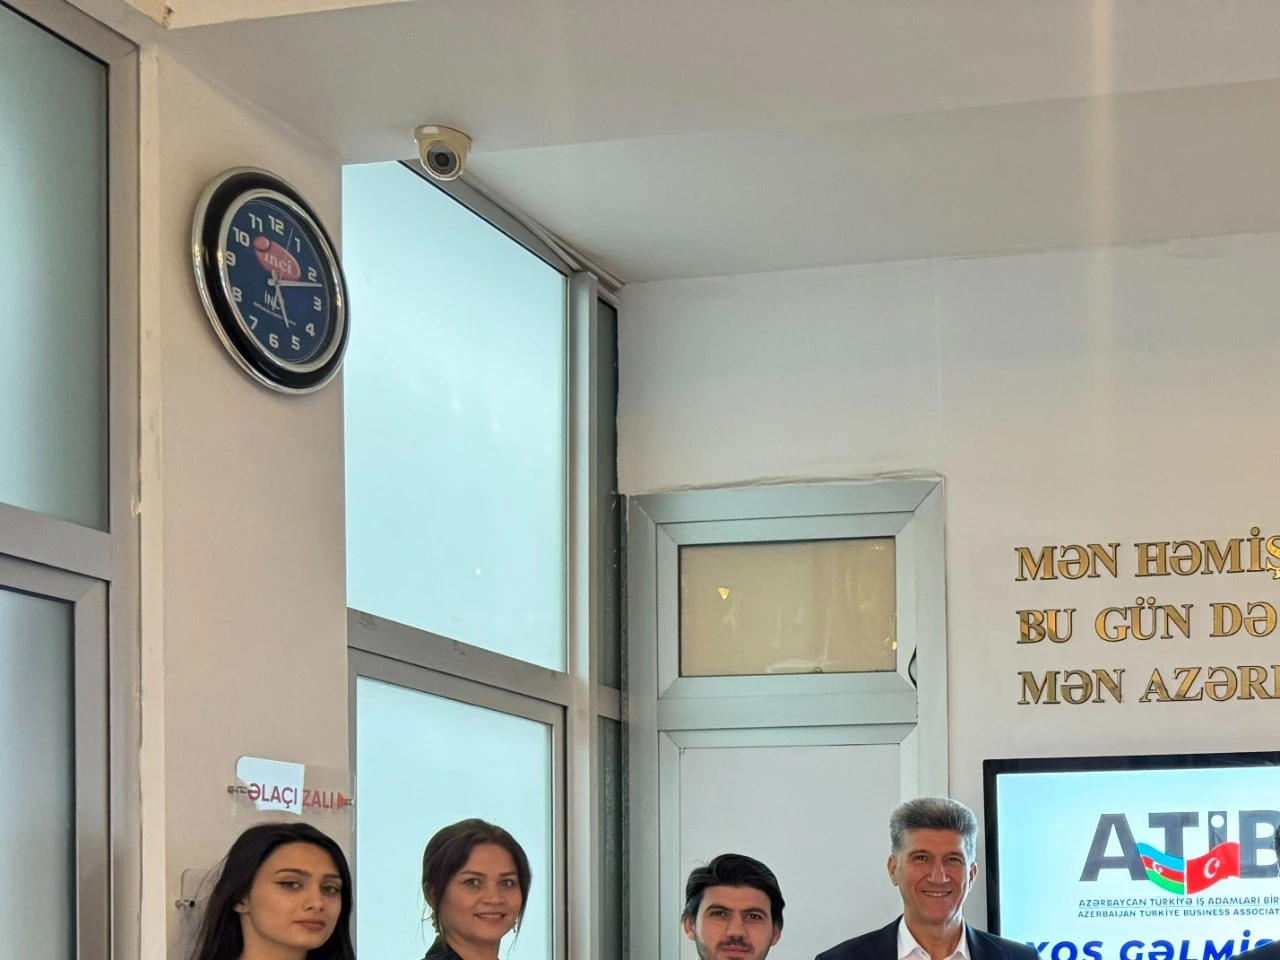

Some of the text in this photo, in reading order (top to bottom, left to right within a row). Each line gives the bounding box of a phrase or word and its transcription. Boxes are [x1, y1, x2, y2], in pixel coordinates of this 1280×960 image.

[249, 213, 263, 232] 11
[268, 215, 284, 235] 12
[233, 227, 250, 247] 10
[294, 237, 301, 252] 1
[226, 251, 236, 267] 9
[308, 267, 317, 281] 2
[231, 286, 242, 302] 8
[313, 296, 322, 312] 3
[249, 315, 259, 330] 7
[305, 322, 315, 338] 4
[269, 333, 279, 349] 6
[291, 334, 301, 351] 5
[1015, 542, 1121, 581] MƏN
[1016, 607, 1077, 645] BU
[1094, 596, 1194, 643] GÜN
[1209, 601, 1278, 638] DƏ
[1017, 668, 1126, 706] MƏN
[302, 789, 334, 809] ZALI
[1079, 898, 1147, 907] AZƏRBAYCAN
[1208, 897, 1260, 905] ADAMLARI
[1078, 910, 1136, 918] AZERBAIJAN
[1183, 908, 1230, 917] BUSINESS
